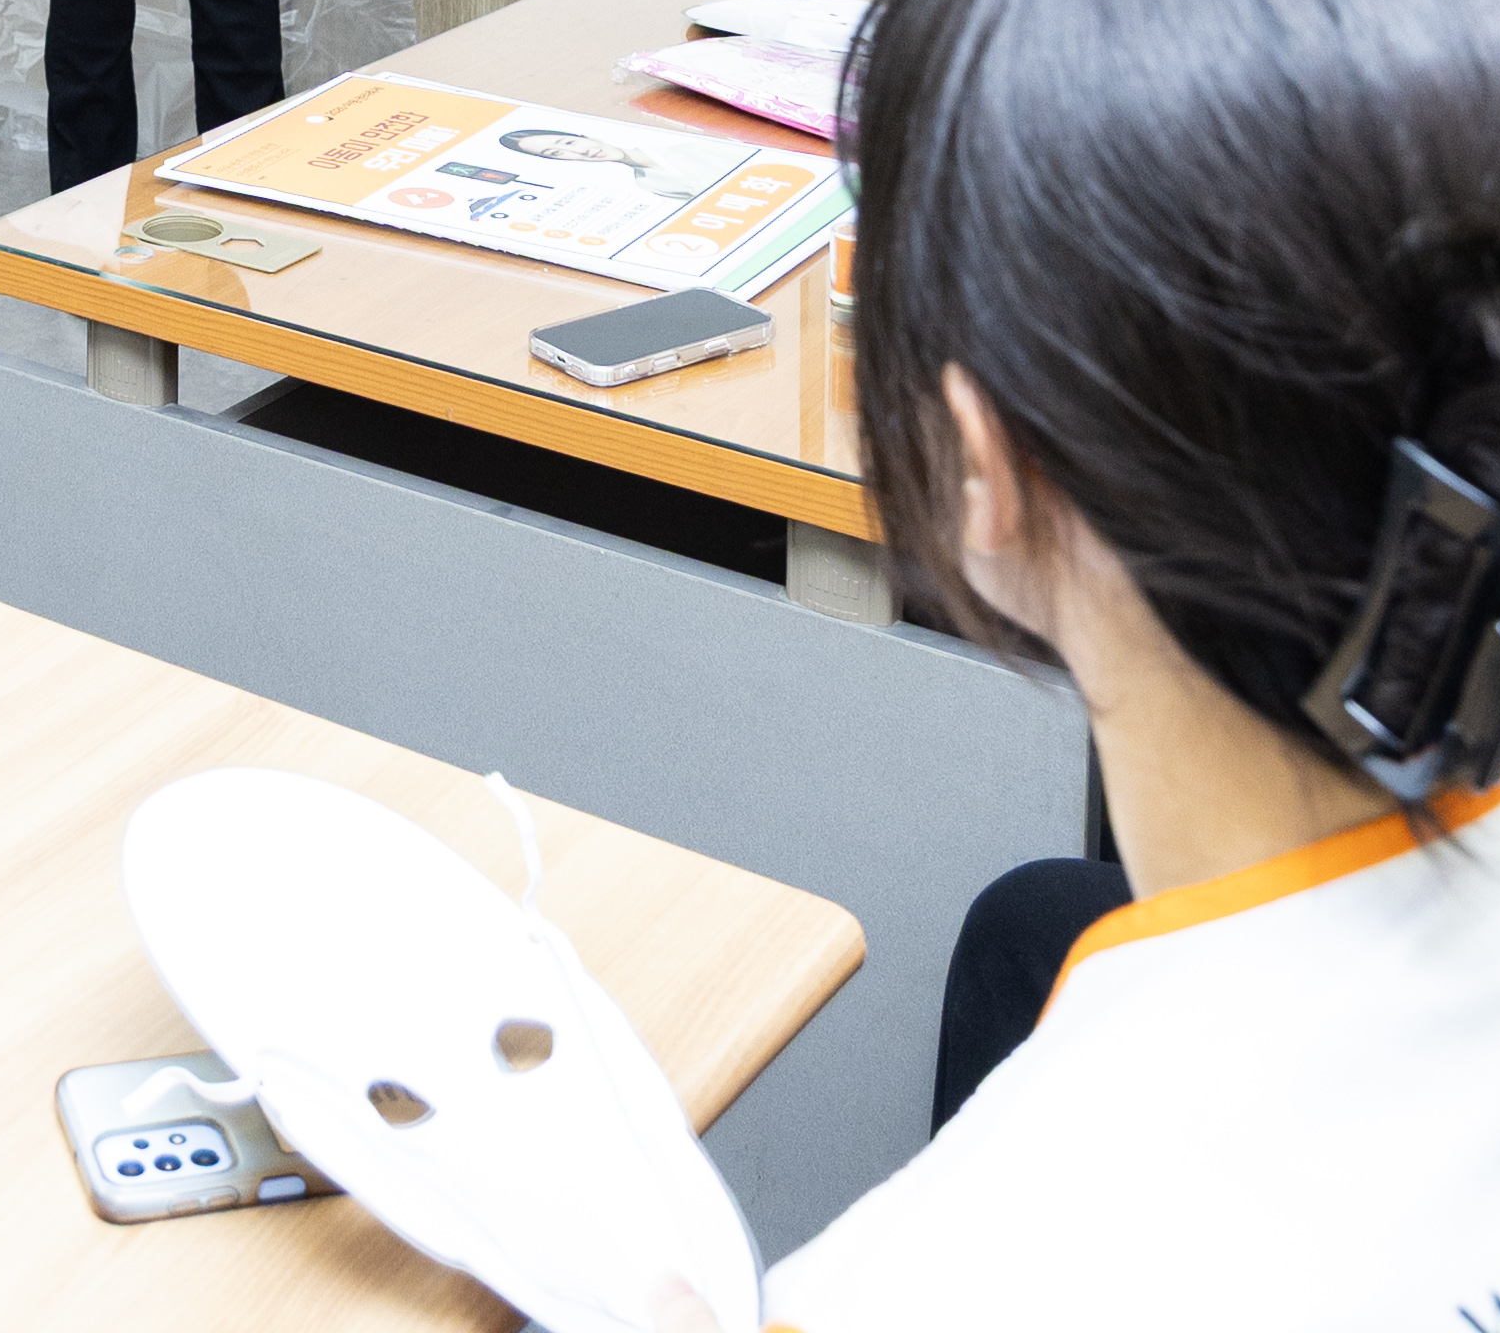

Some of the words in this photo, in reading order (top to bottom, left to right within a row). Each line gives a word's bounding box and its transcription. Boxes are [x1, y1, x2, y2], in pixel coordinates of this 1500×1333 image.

[307, 138, 380, 170] 아동이
[360, 111, 430, 141] 안전한
[363, 144, 421, 172] 우리
[397, 124, 461, 153] 마을!
[664, 238, 704, 252] 2
